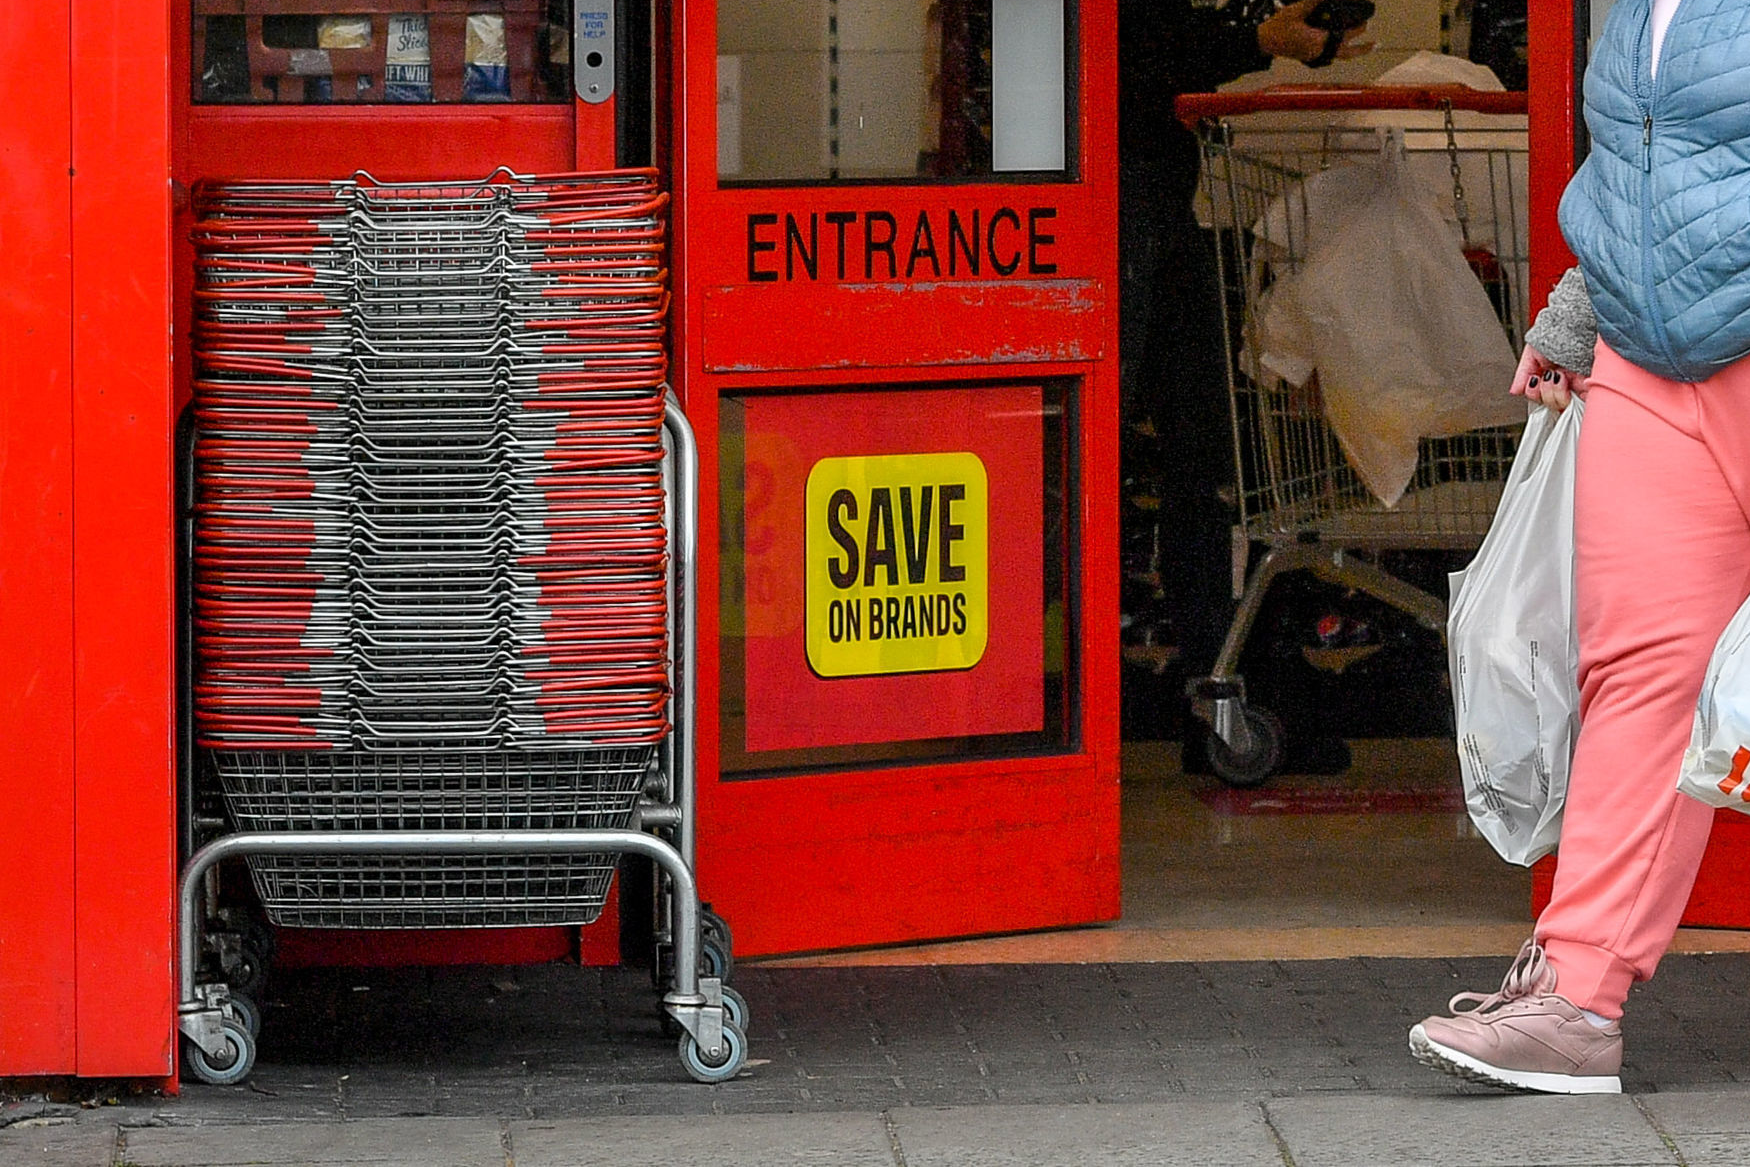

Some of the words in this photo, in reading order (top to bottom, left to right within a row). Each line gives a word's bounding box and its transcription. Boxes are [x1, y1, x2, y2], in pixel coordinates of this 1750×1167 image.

[404, 65, 429, 82] WHI
[747, 207, 1058, 283] ENTRANCE
[826, 483, 967, 590] SAVE
[828, 599, 861, 644] ON
[868, 592, 968, 641] BRANDS
